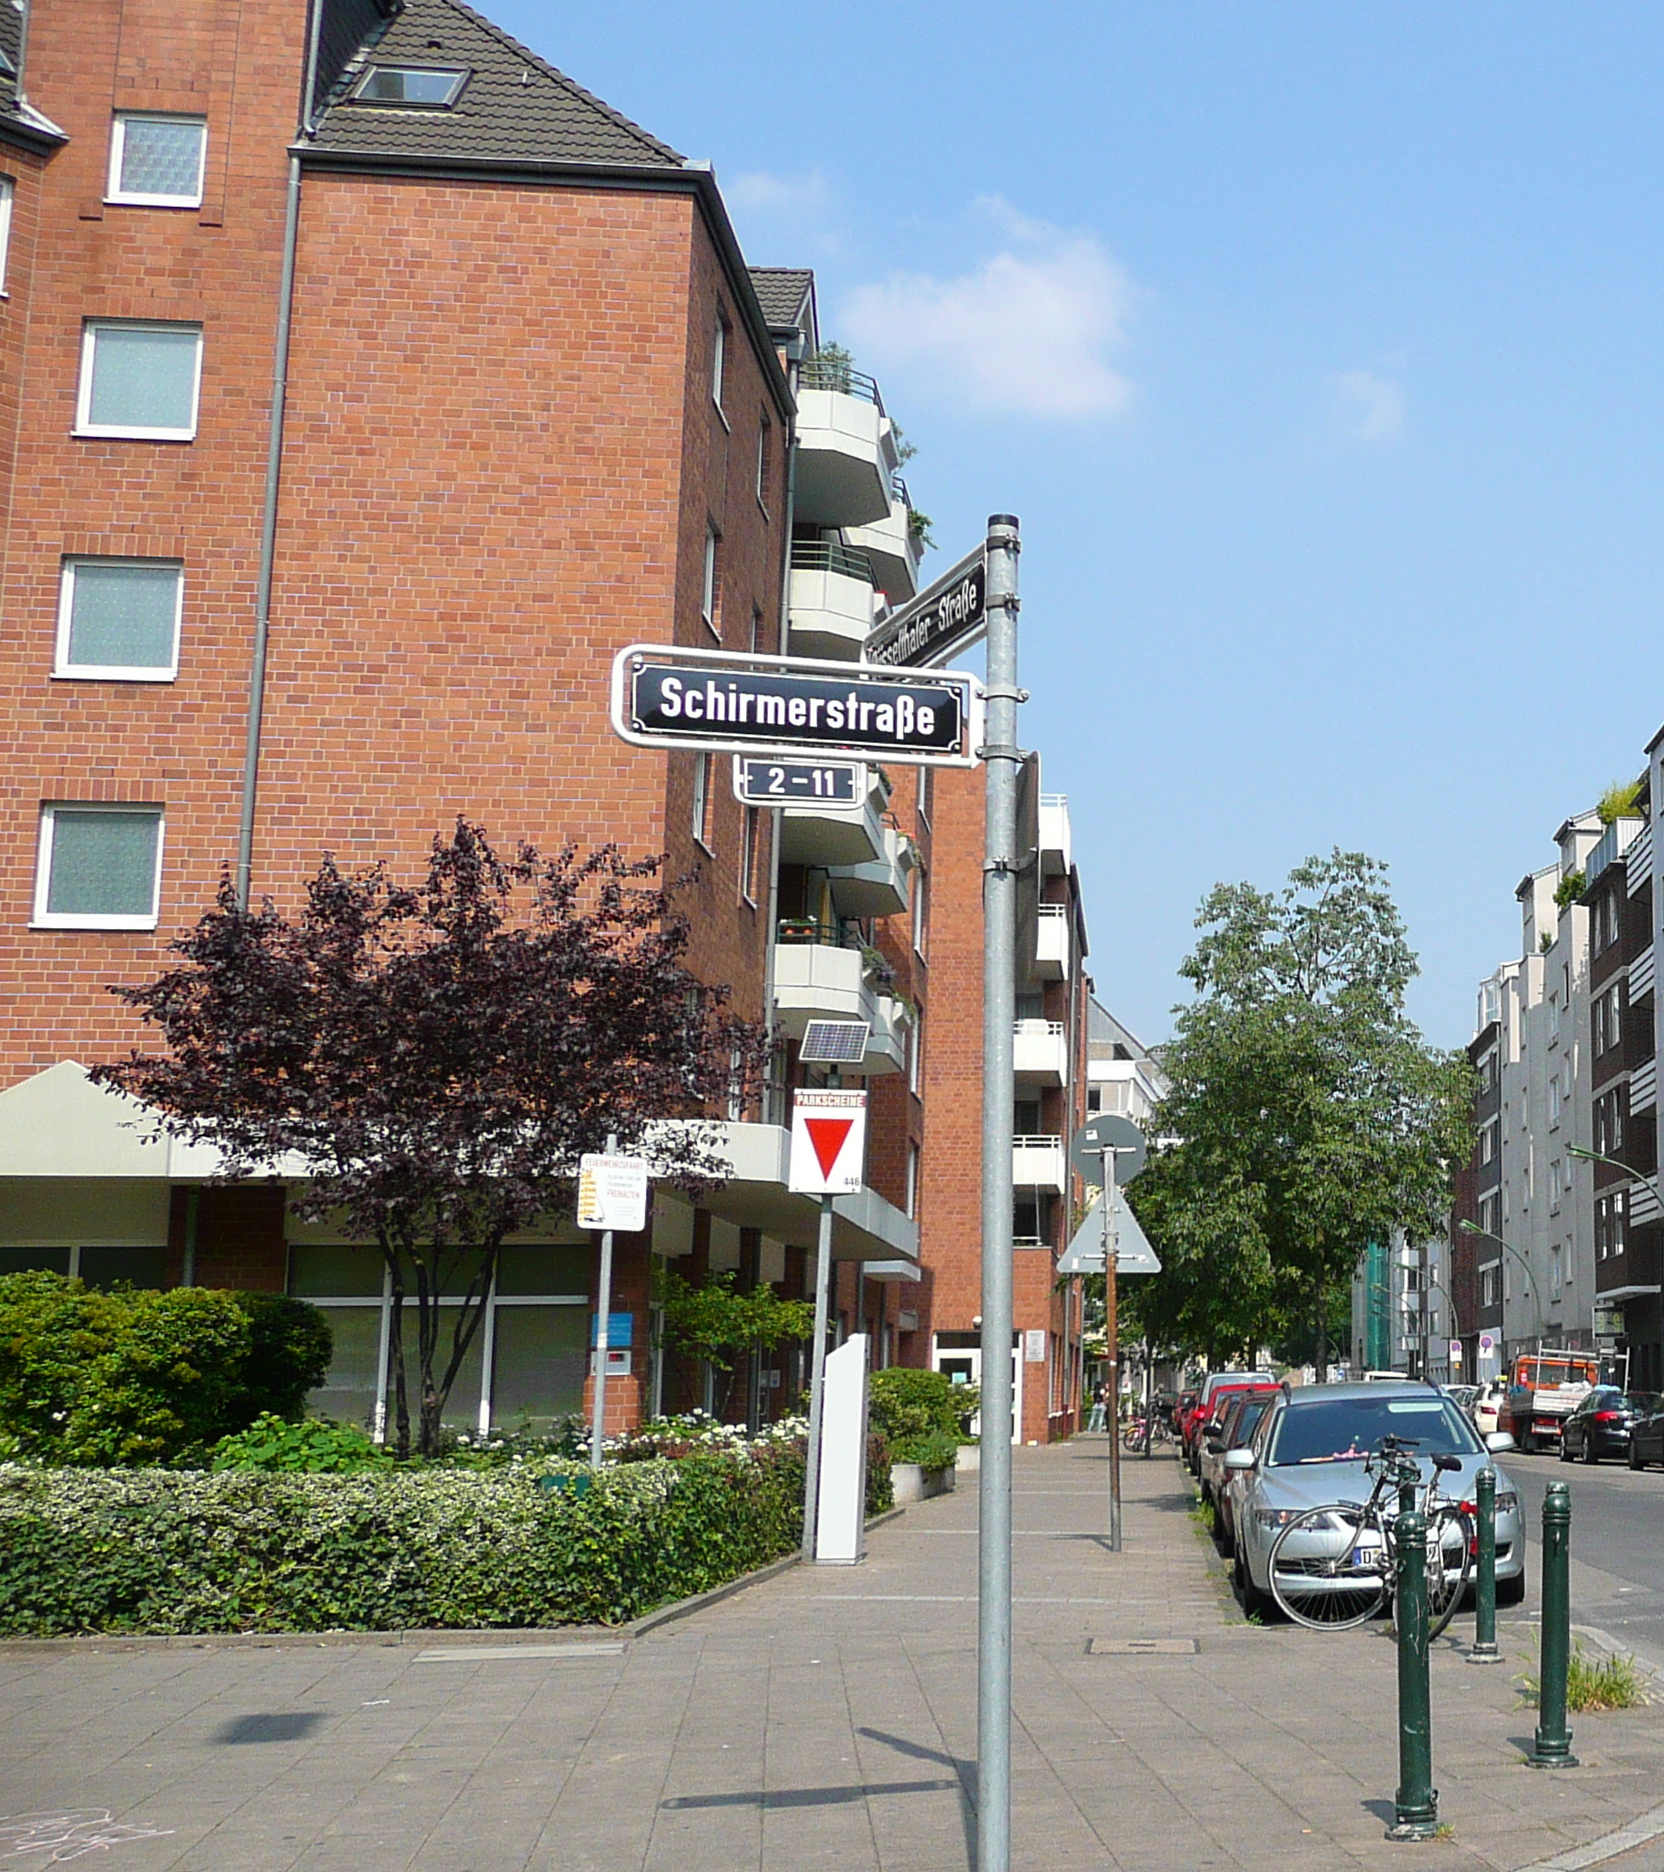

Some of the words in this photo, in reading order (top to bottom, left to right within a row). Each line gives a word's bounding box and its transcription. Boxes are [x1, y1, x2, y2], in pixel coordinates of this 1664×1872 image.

[938, 579, 977, 632] Straße
[660, 676, 936, 740] Schirmerstraße
[796, 1094, 865, 1107] PARKSCHEINE
[843, 1177, 860, 1187] 446
[1362, 1551, 1372, 1564] D
